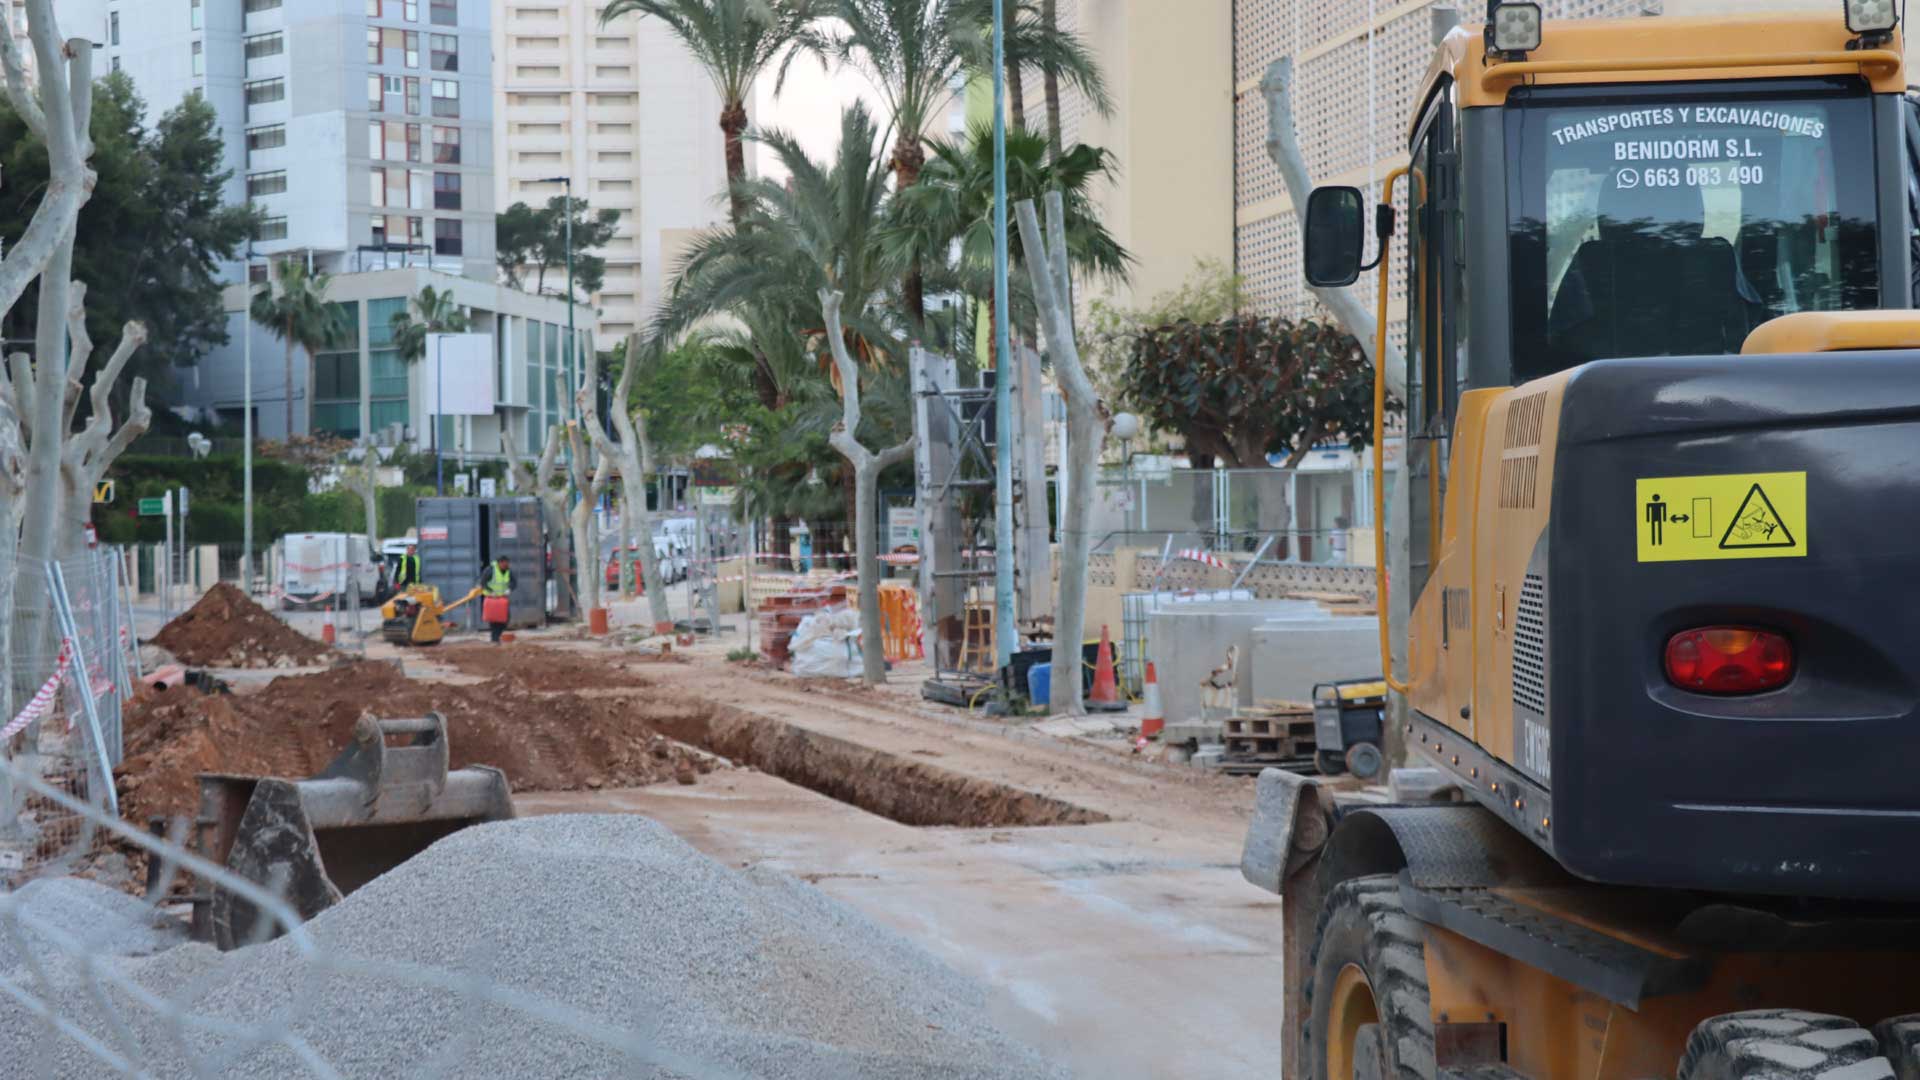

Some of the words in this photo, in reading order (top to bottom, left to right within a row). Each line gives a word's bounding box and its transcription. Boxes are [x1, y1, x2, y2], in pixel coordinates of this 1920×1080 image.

[1552, 108, 1674, 145] TRANSPORTES
[1678, 107, 1690, 123] Y
[1695, 107, 1825, 139] EXCAVACIONES
[1614, 139, 1720, 160] BENIDORM
[1726, 138, 1763, 158] S.L.
[1644, 168, 1680, 187] 663
[1686, 167, 1721, 186] 083
[1727, 165, 1764, 185] 490
